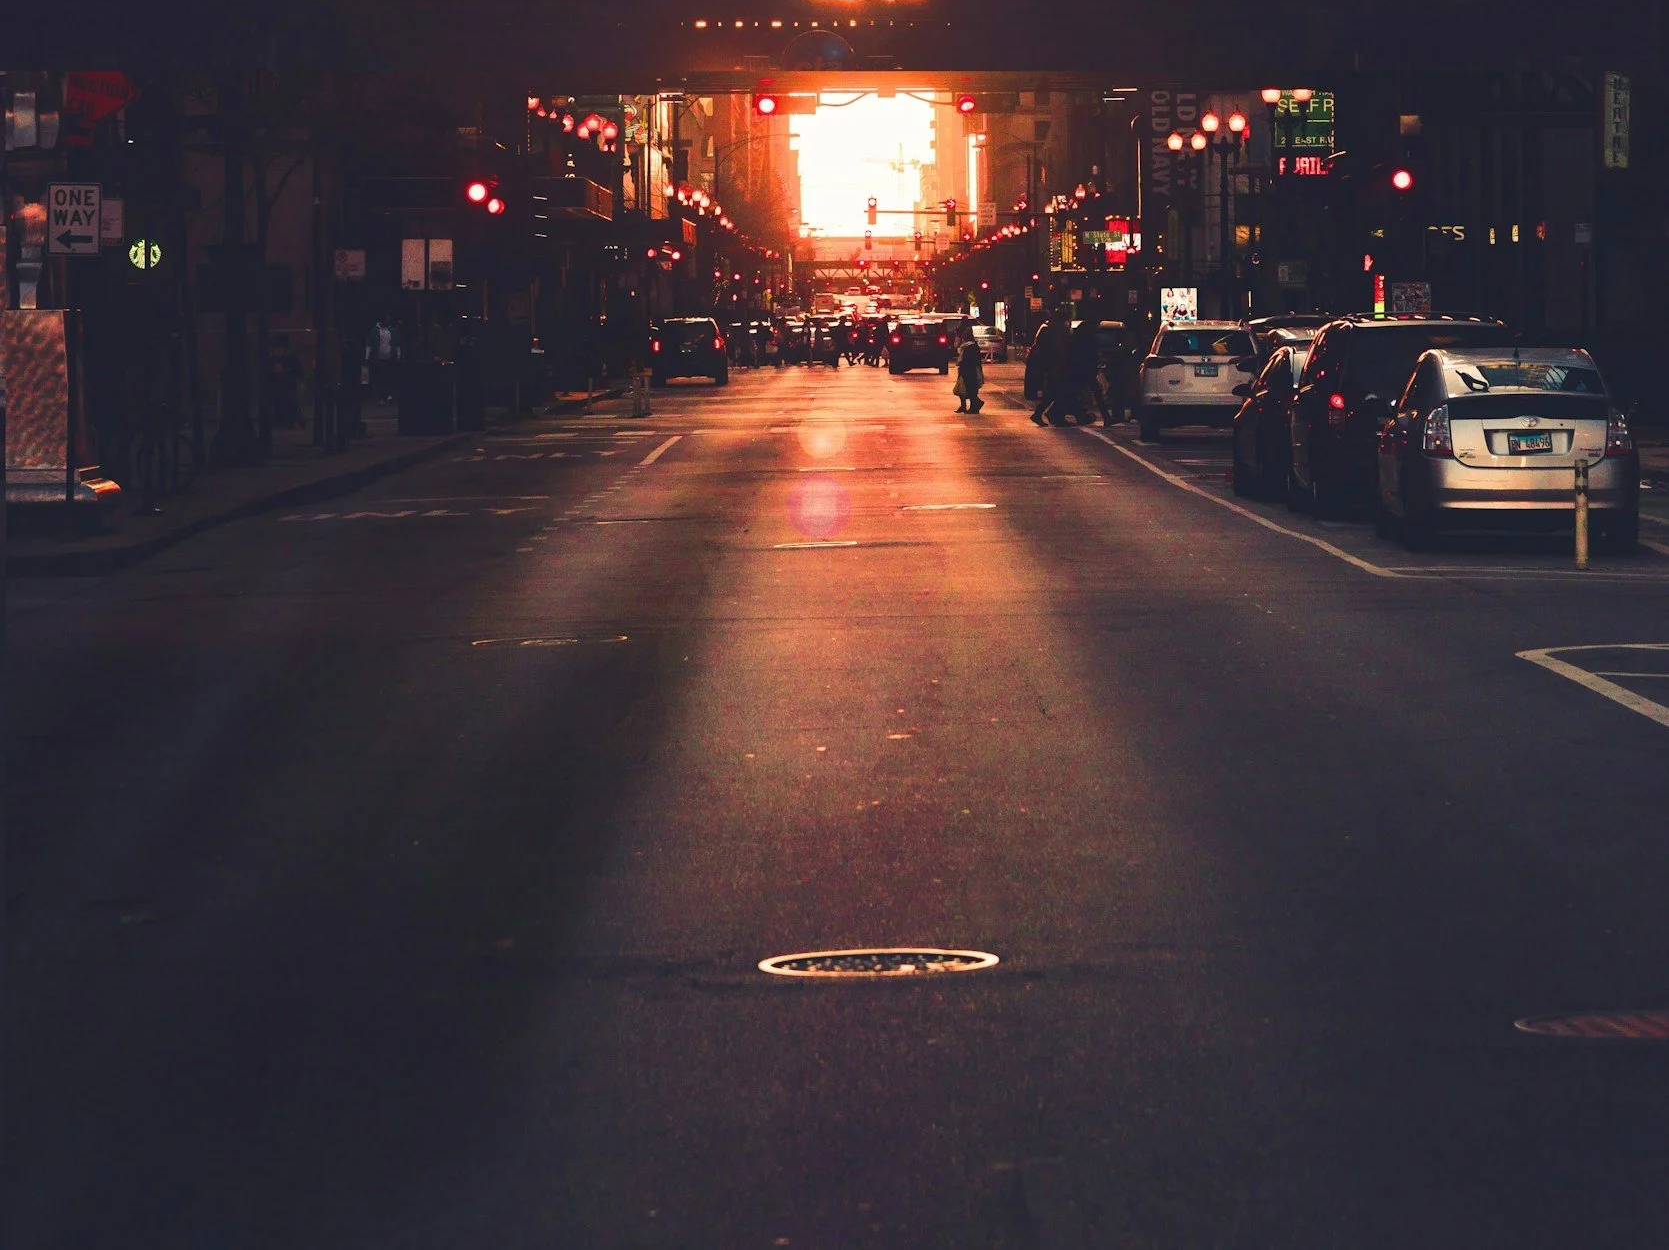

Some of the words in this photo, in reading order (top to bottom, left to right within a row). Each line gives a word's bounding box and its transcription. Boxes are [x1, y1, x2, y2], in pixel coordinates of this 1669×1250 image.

[1151, 90, 1171, 132] OLD
[1277, 99, 1319, 113] SEF
[1151, 138, 1172, 196] NAVY
[55, 190, 95, 206] ONE
[54, 210, 96, 225] WAY
[1092, 231, 1110, 239] State
